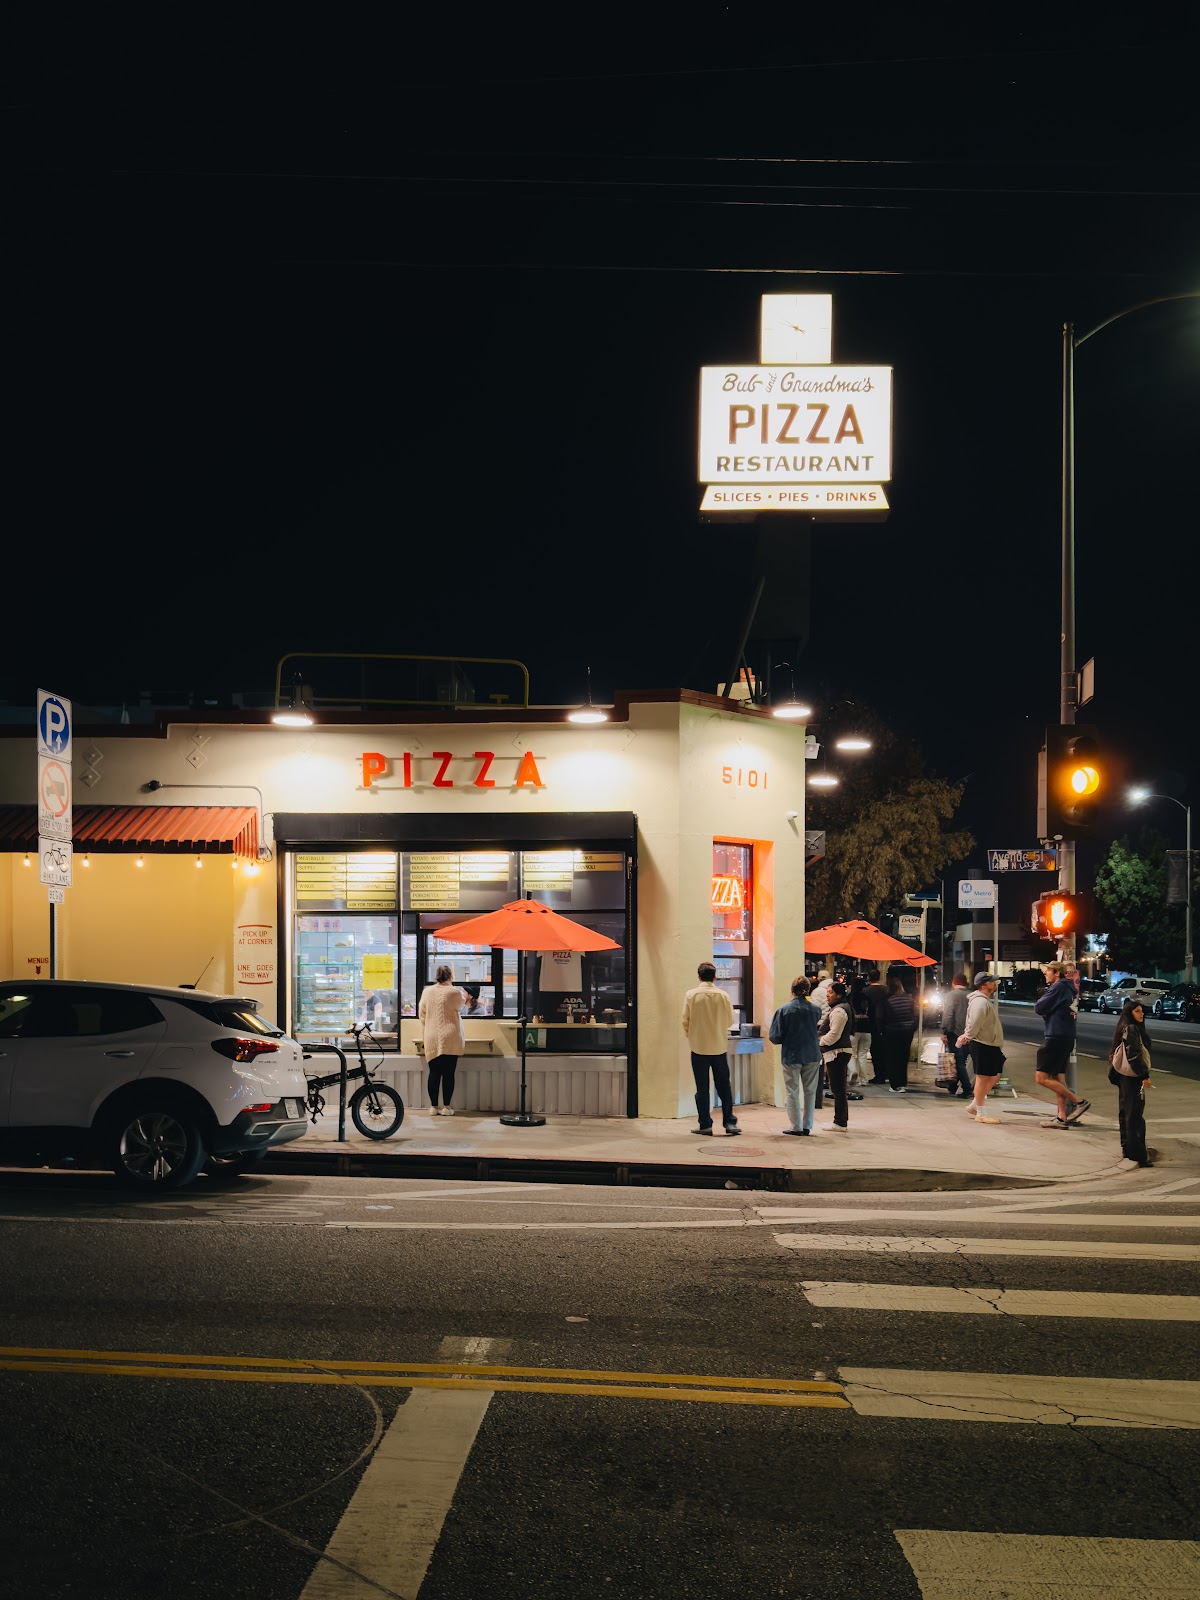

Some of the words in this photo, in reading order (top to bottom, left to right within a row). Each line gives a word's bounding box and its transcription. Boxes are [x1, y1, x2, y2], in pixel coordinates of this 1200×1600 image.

[722, 373, 762, 392] Bub
[780, 372, 874, 393] Grandma's
[728, 403, 864, 444] PIZZA
[717, 456, 874, 472] RESTAURANT
[713, 492, 762, 502] SLICES
[779, 492, 809, 502] PIES
[826, 492, 877, 502] DRINKS
[46, 702, 65, 747] P
[362, 751, 543, 787] PIZZA
[722, 766, 767, 789] 5101
[992, 851, 1028, 862] Avenue
[43, 872, 55, 883] BIKE
[55, 874, 68, 885] LANE
[712, 878, 741, 906] ZZA
[552, 951, 572, 959] PIZZA
[525, 1032, 535, 1044] A
